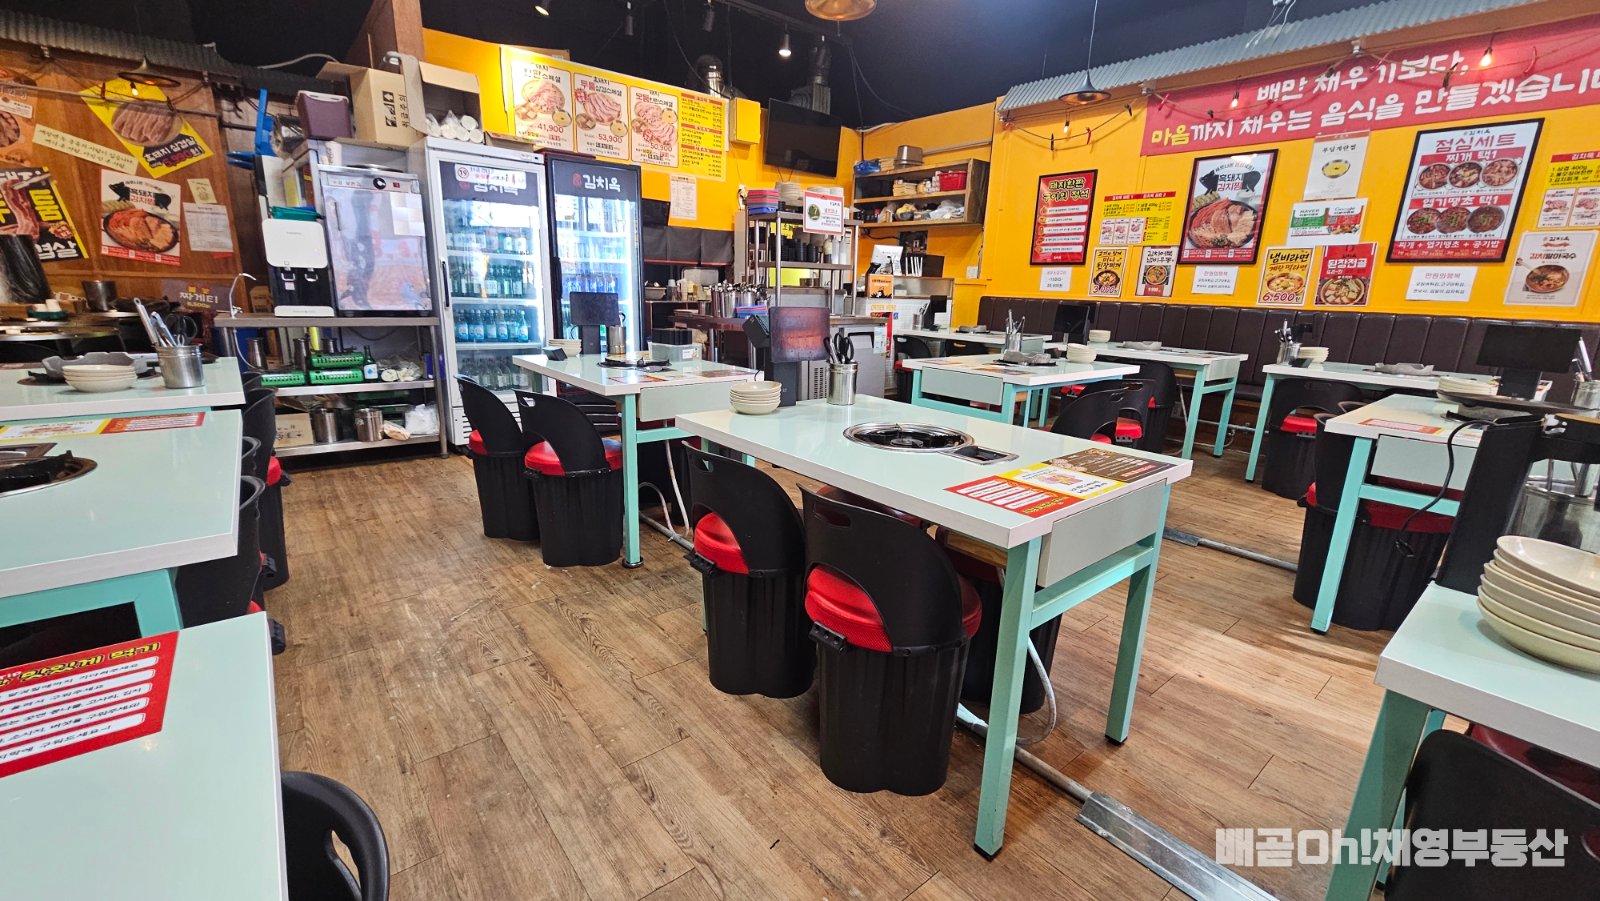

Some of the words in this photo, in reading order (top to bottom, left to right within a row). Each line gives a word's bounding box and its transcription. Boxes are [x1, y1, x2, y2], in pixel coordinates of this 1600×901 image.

[1256, 77, 1308, 102] 배만
[399, 93, 409, 128] 취급주의
[1151, 119, 1233, 146] 마음까지
[1238, 110, 1313, 135] 채우는
[1320, 93, 1405, 128] 음식을
[1435, 133, 1516, 153] 점심세트
[1446, 152, 1472, 162] 찌개
[582, 173, 621, 192] 김치옥
[1218, 173, 1245, 182] 흑돼지
[1269, 252, 1310, 264] 냄비라면
[1327, 258, 1368, 269] 된장전골
[20, 655, 104, 682] 맛있게
[109, 642, 161, 661] 먹기
